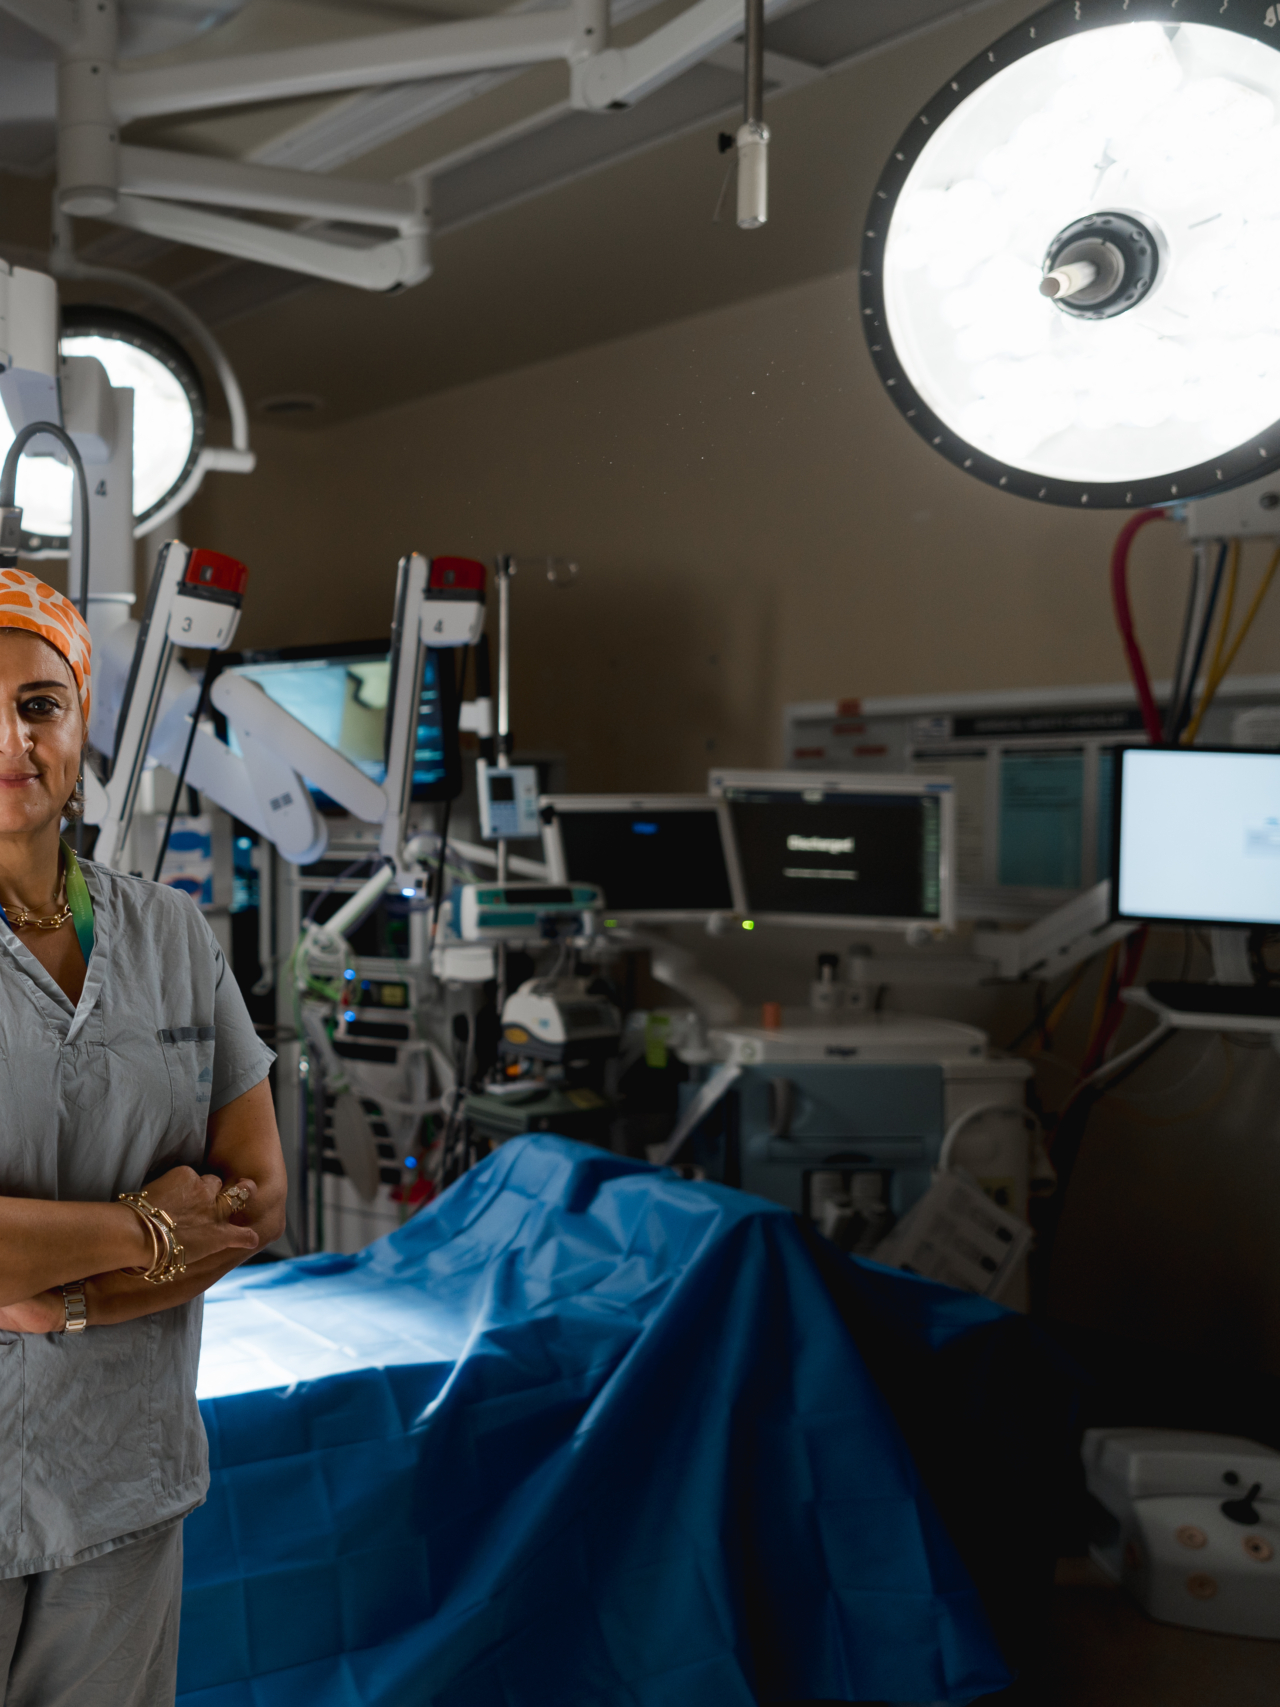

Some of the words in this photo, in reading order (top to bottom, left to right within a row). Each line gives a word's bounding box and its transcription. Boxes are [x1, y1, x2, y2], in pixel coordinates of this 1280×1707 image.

[95, 478, 107, 498] 4
[181, 616, 193, 633] 3
[433, 618, 444, 634] 4
